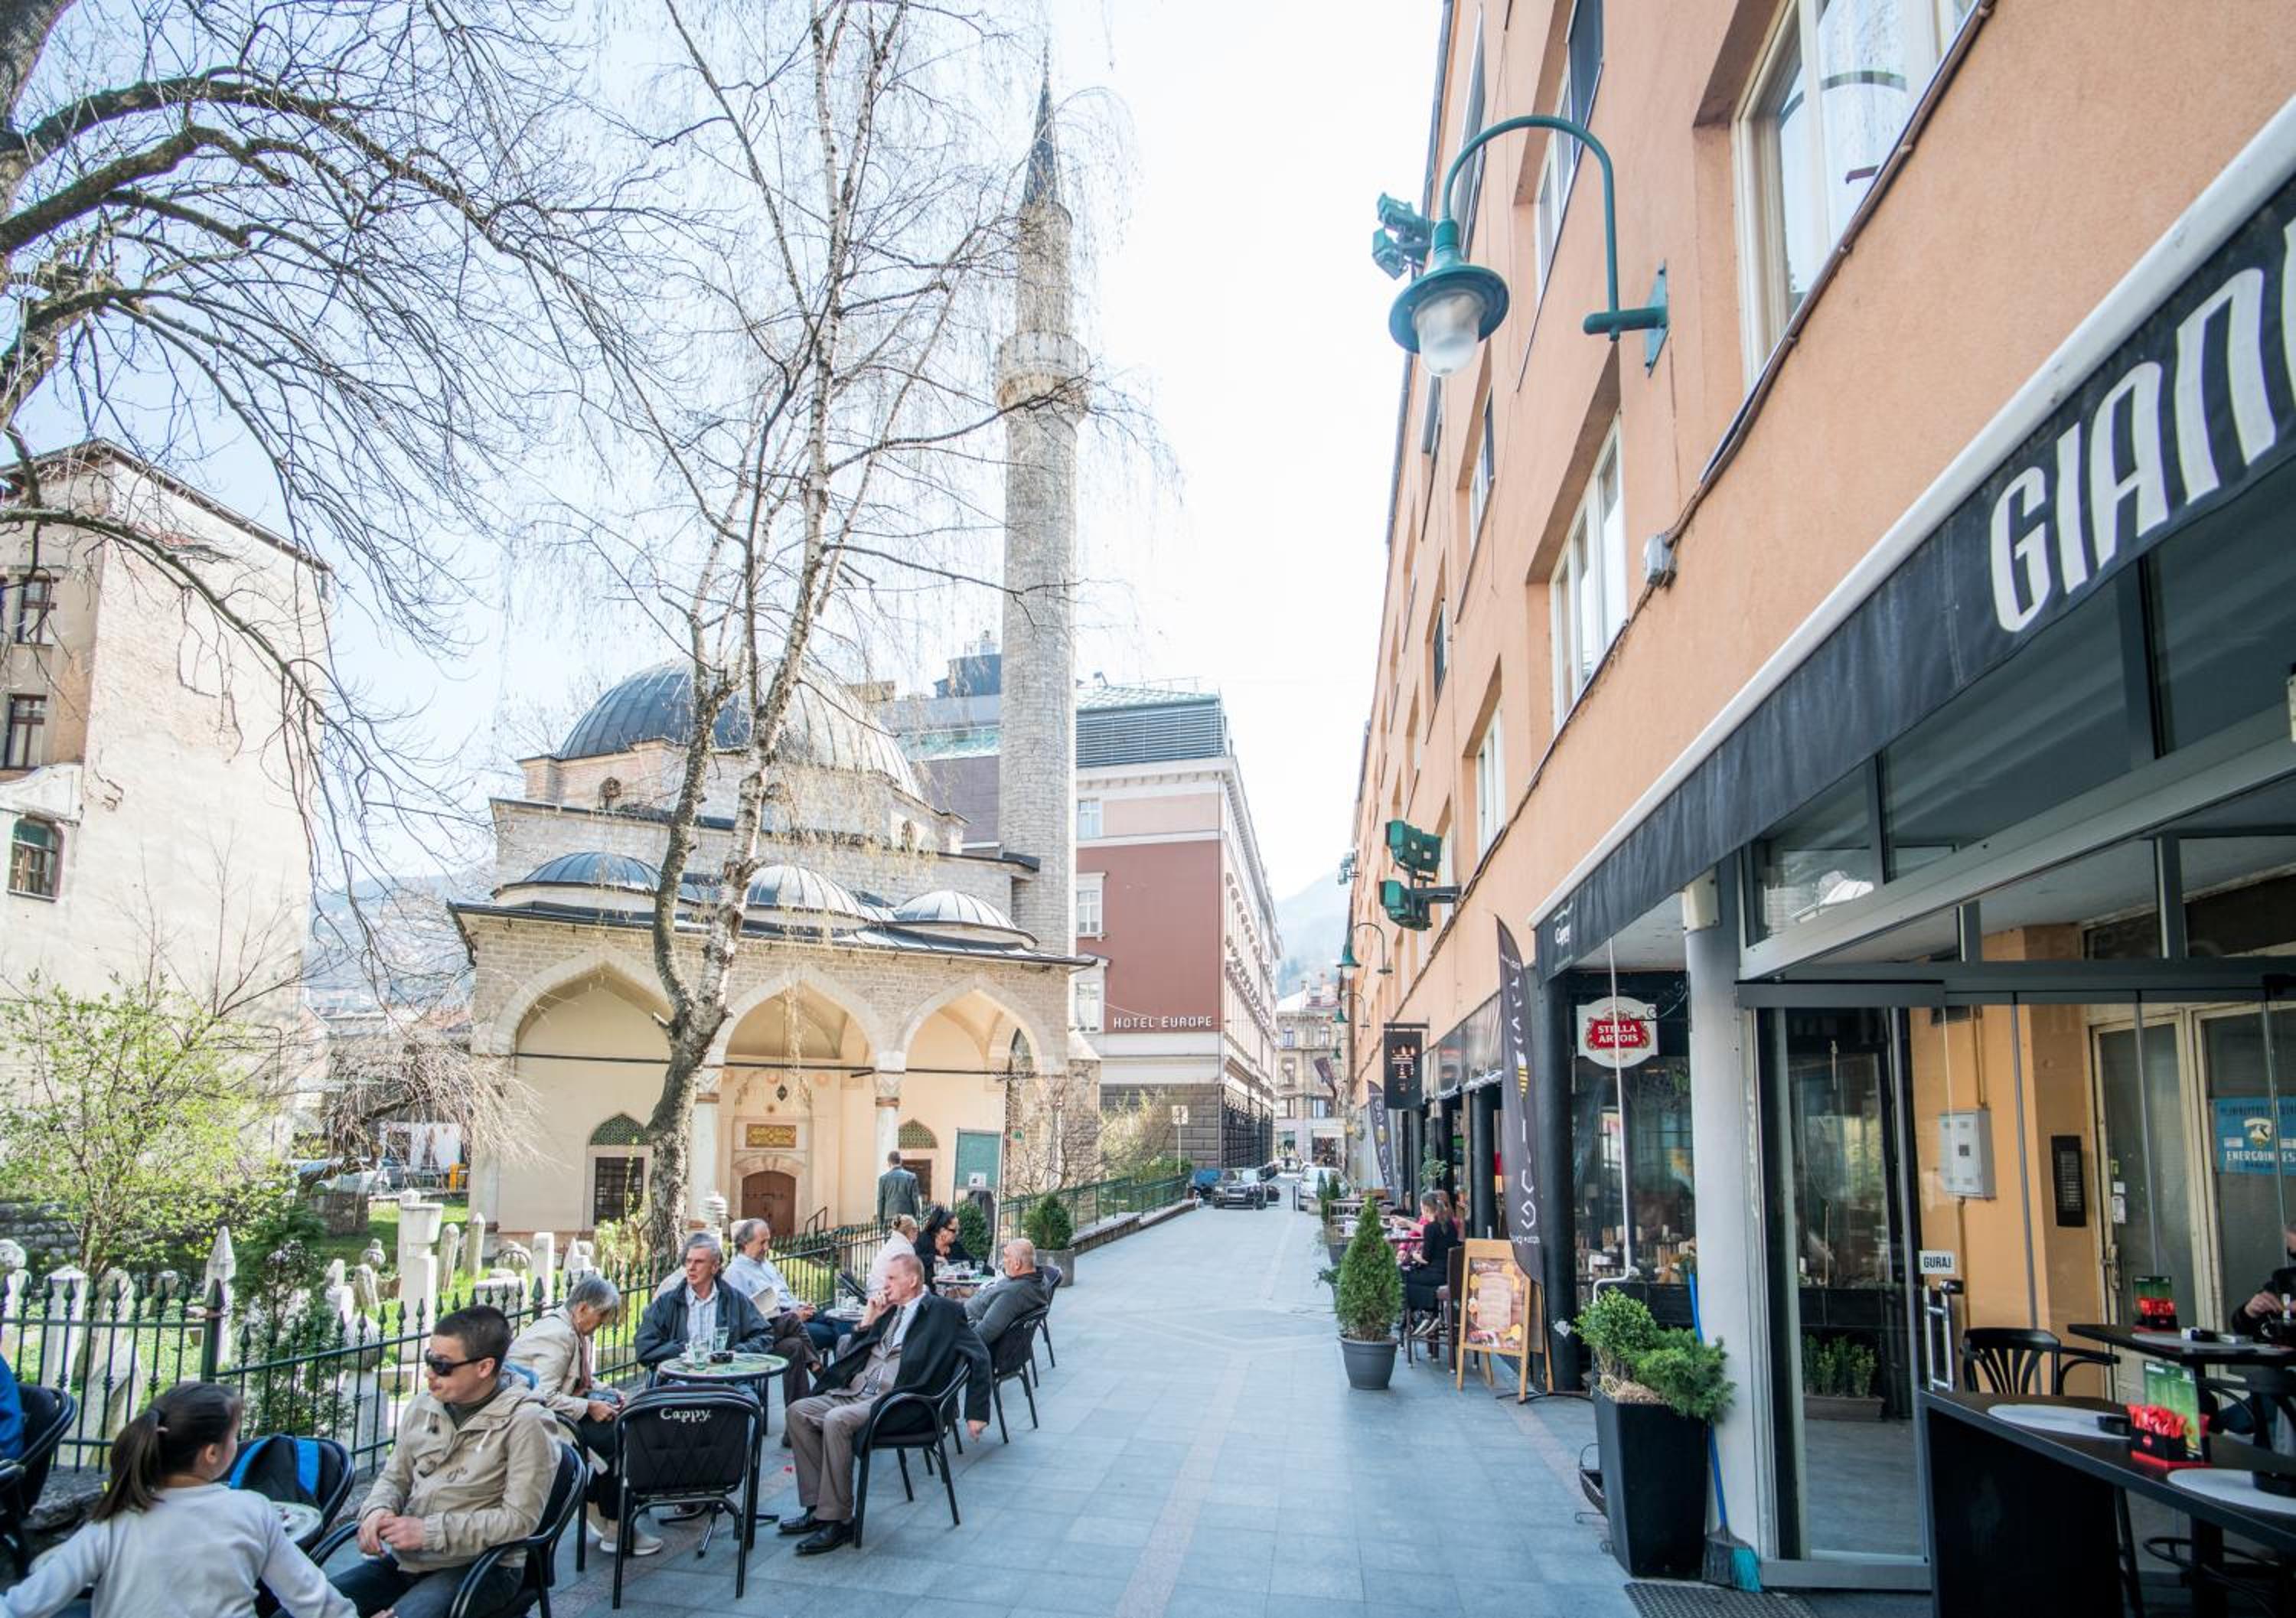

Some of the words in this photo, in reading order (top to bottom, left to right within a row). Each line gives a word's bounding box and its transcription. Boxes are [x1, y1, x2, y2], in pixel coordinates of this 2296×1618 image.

[1991, 217, 2296, 633] GIAN
[1114, 1016, 1155, 1028] HOTEL
[1161, 1016, 1213, 1028] EUROPE
[1597, 1024, 1637, 1034] STELLA
[660, 1408, 711, 1423] Cappy
